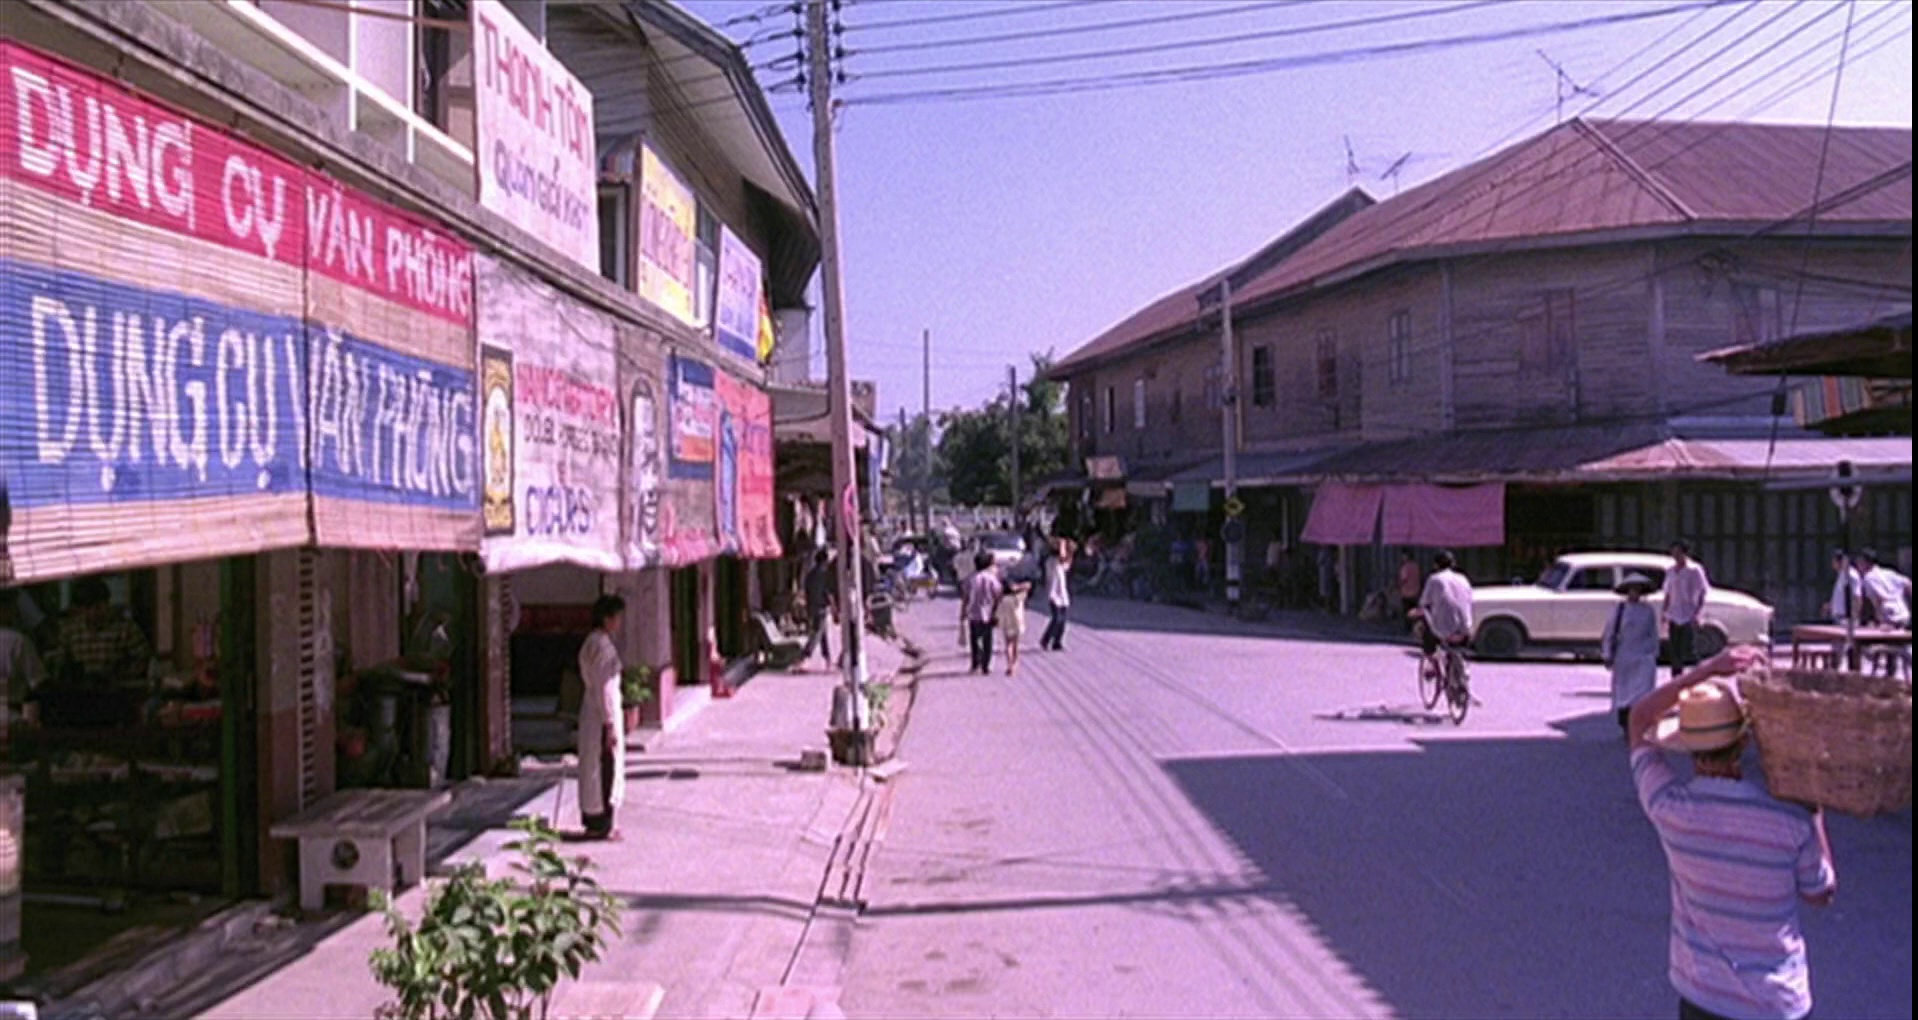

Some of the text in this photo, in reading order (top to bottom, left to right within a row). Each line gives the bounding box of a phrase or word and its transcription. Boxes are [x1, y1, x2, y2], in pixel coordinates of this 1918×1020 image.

[10, 66, 195, 230] DỤNG
[222, 155, 286, 260] CỤ
[31, 295, 207, 492] DỤNG
[217, 325, 277, 489] CỤ
